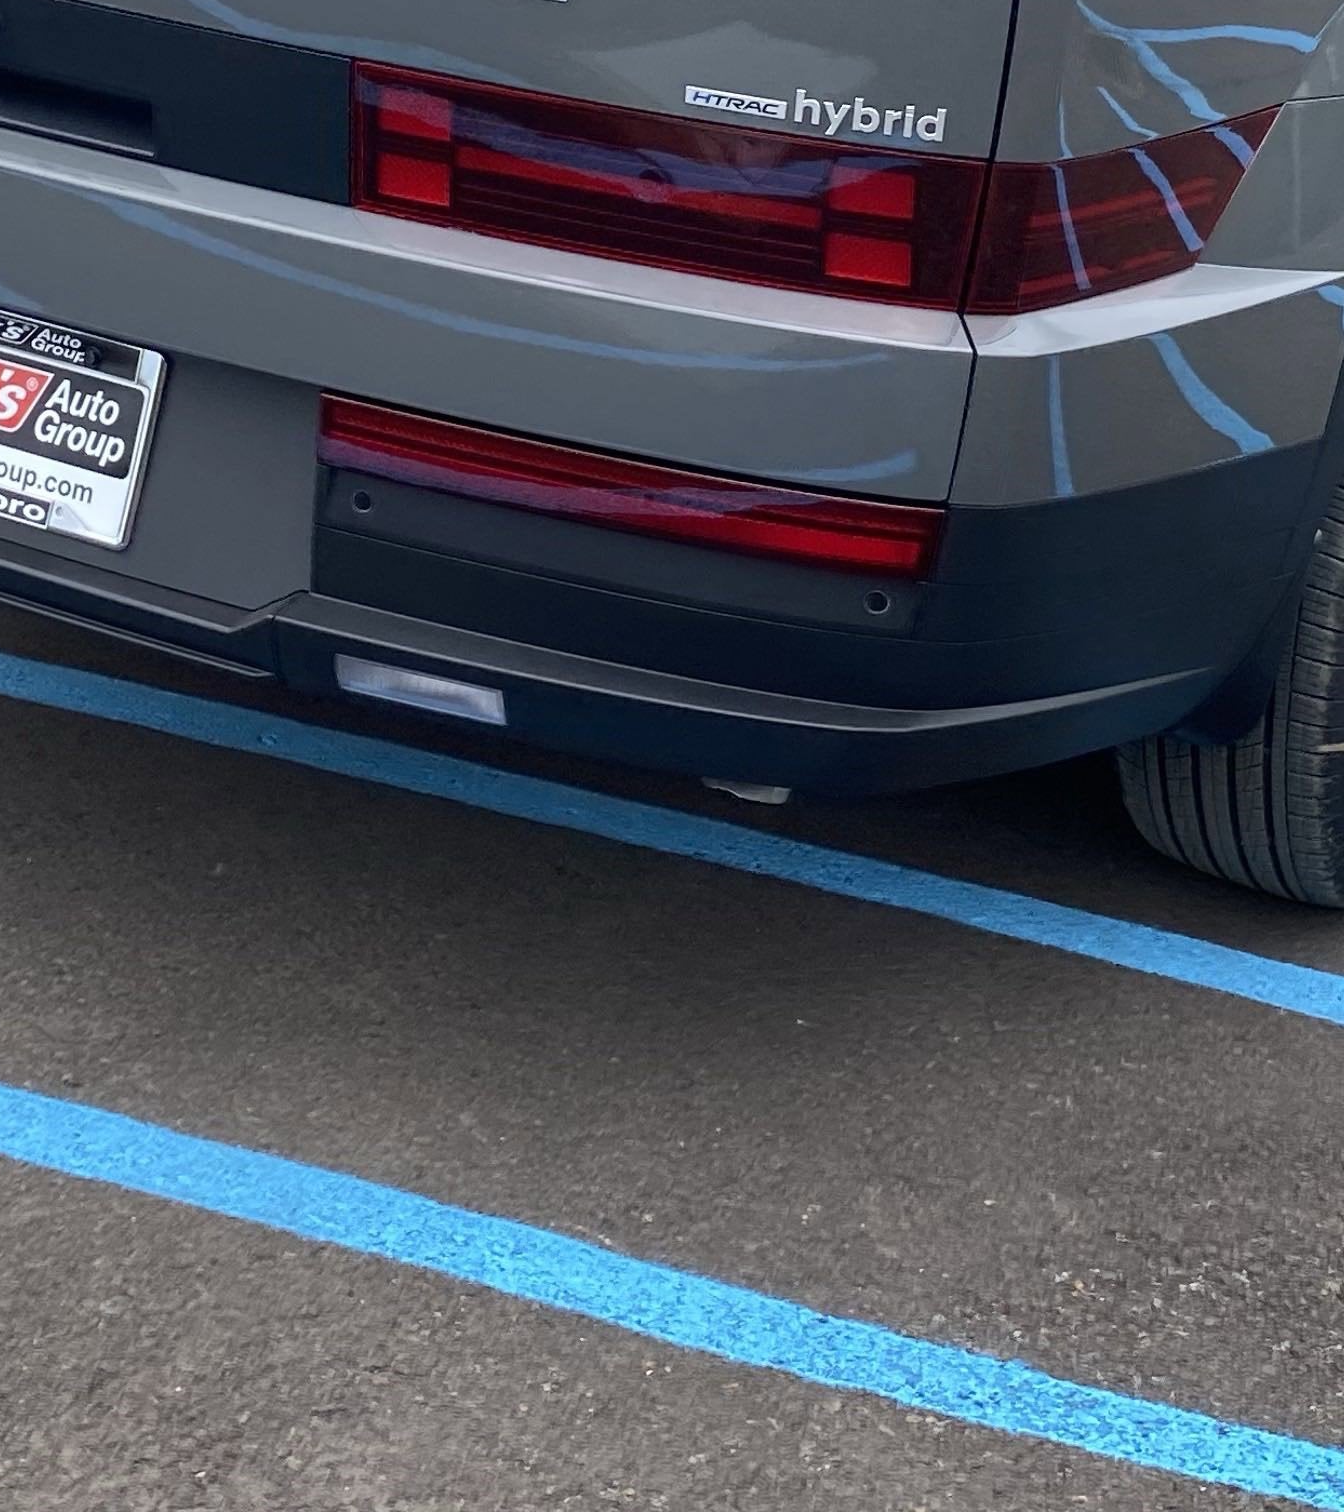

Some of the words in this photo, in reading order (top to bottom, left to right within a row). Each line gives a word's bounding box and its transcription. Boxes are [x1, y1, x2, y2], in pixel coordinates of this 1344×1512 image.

[692, 90, 780, 115] HTRAC
[793, 88, 947, 143] hybrid
[36, 328, 82, 349] Auto
[44, 379, 120, 426] Auto
[34, 410, 125, 467] Group
